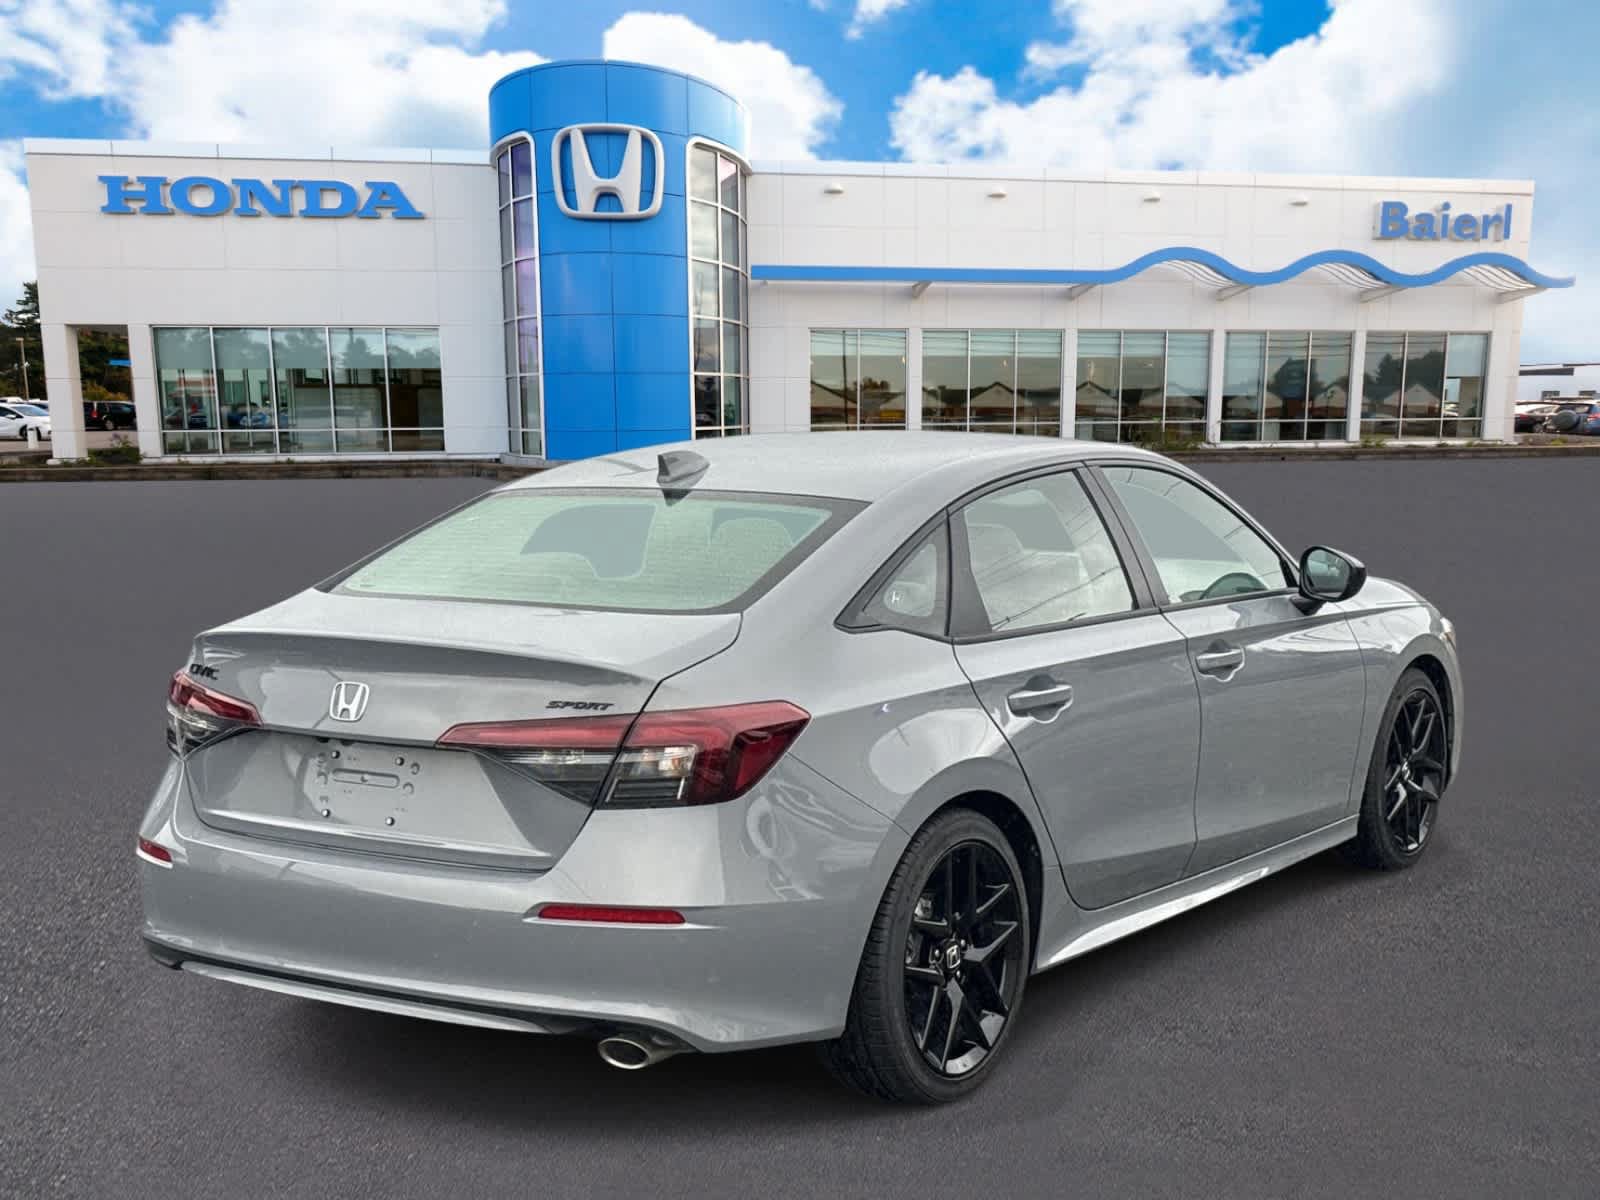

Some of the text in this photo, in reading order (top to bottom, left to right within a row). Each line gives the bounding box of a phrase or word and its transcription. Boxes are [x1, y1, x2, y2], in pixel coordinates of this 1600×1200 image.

[98, 175, 425, 219] HONDA
[1377, 200, 1513, 240] Baierl
[545, 700, 615, 711] SPORT
